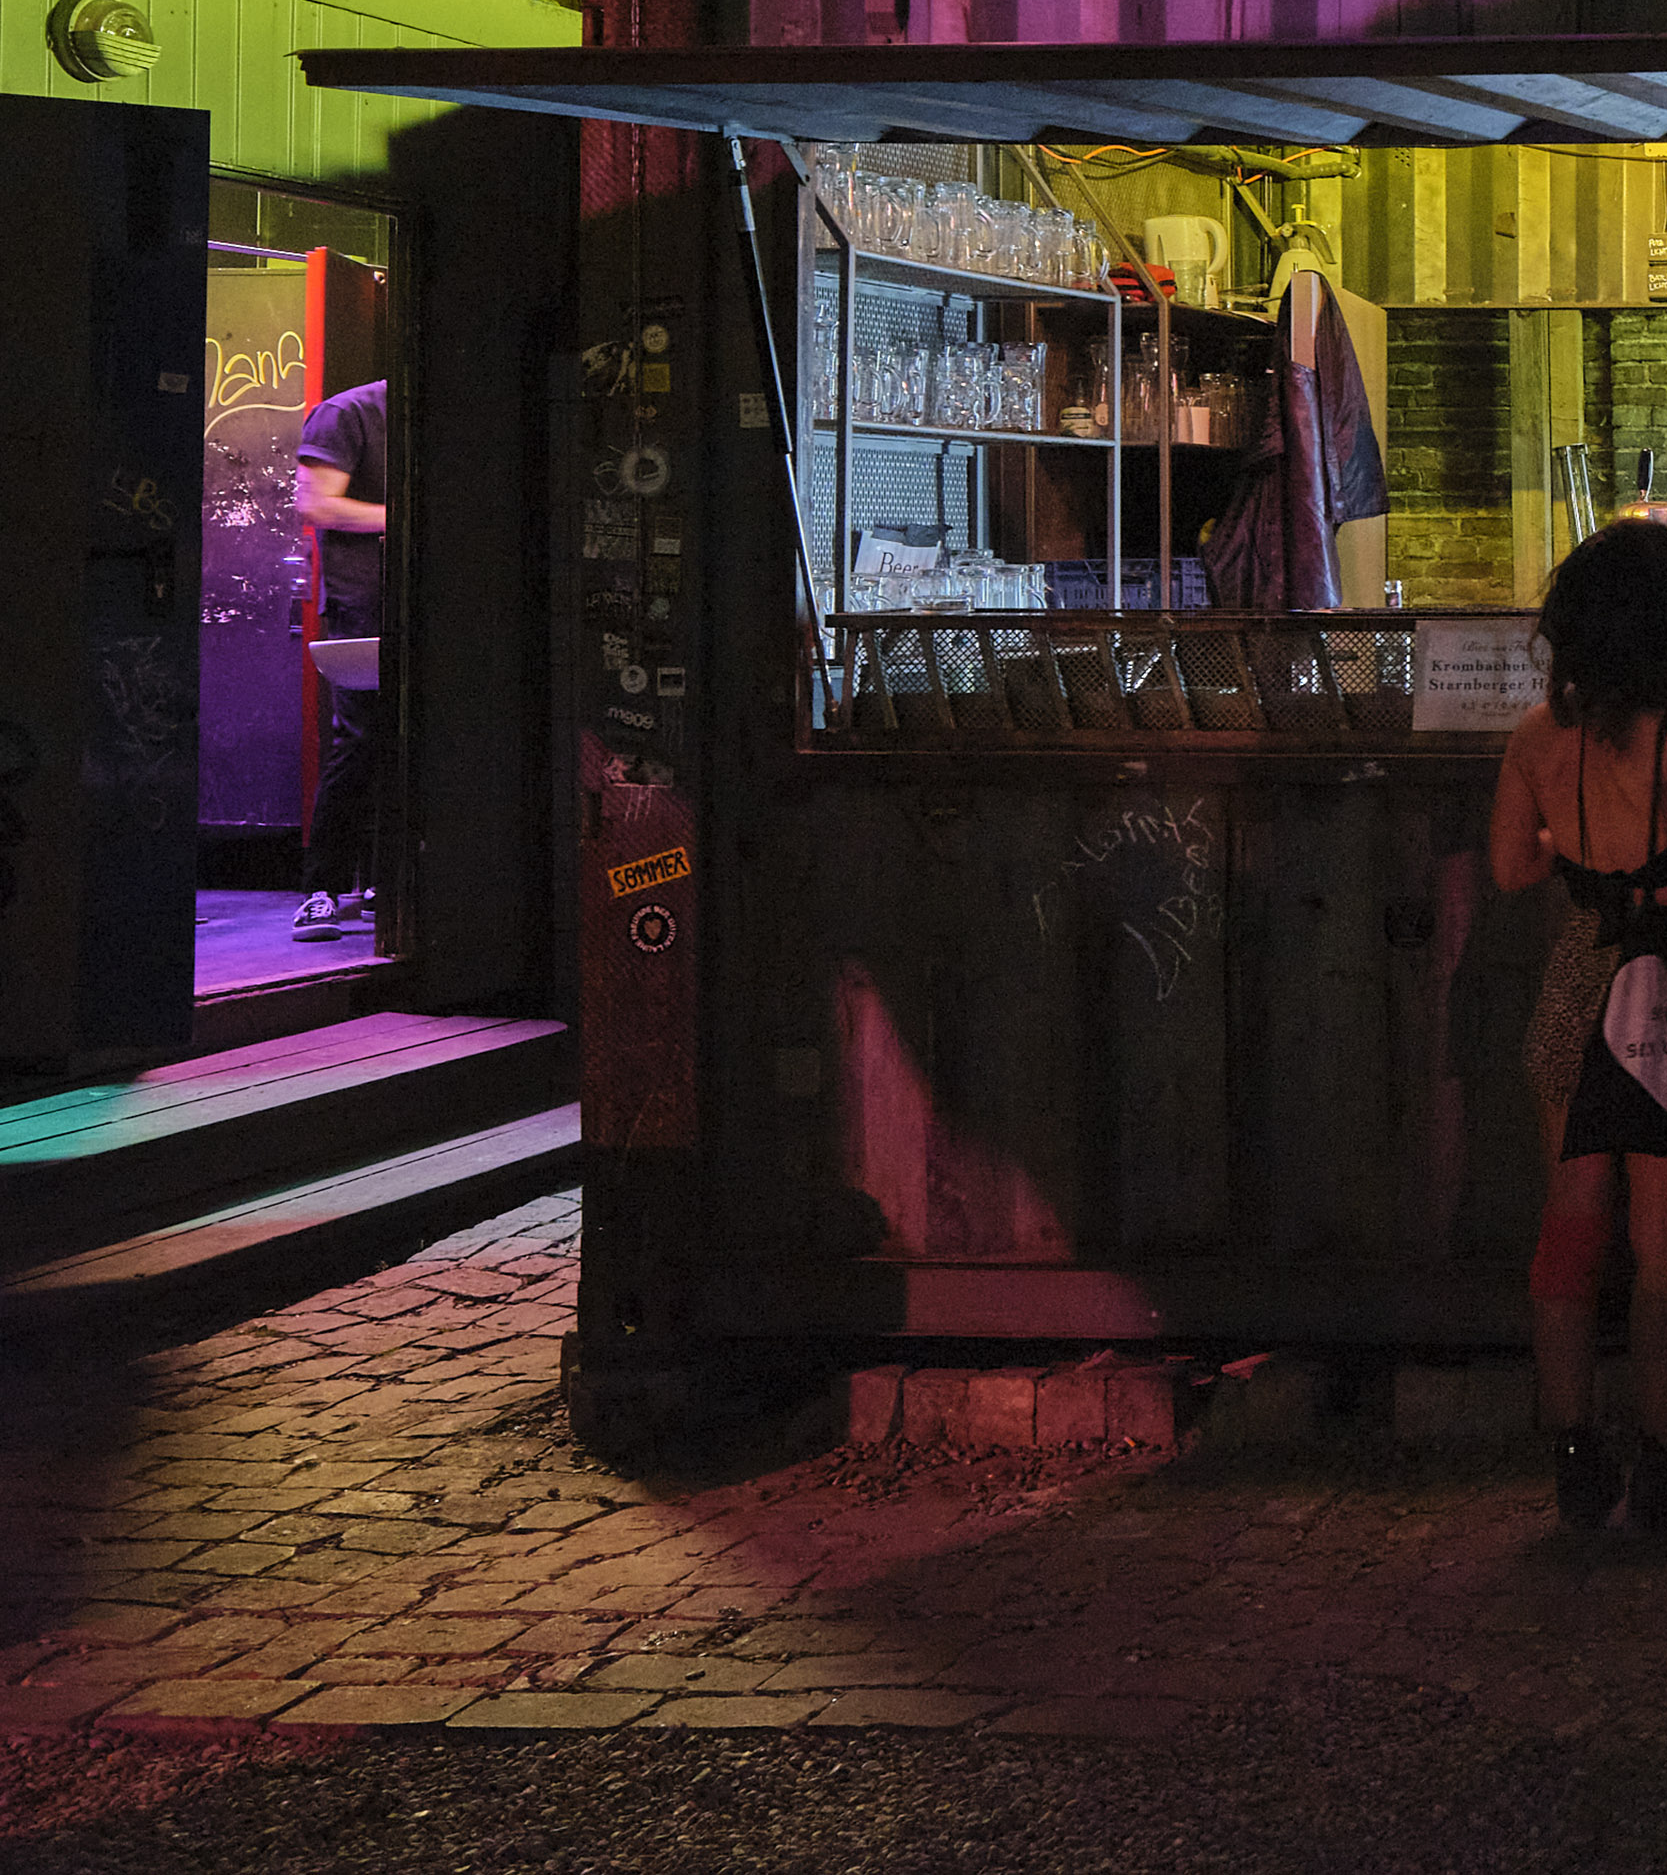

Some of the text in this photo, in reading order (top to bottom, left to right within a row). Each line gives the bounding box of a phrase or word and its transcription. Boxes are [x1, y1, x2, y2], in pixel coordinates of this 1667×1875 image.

[880, 551, 919, 575] Beer
[1432, 659, 1528, 672] Krombacher
[1428, 677, 1524, 693] Starnberger
